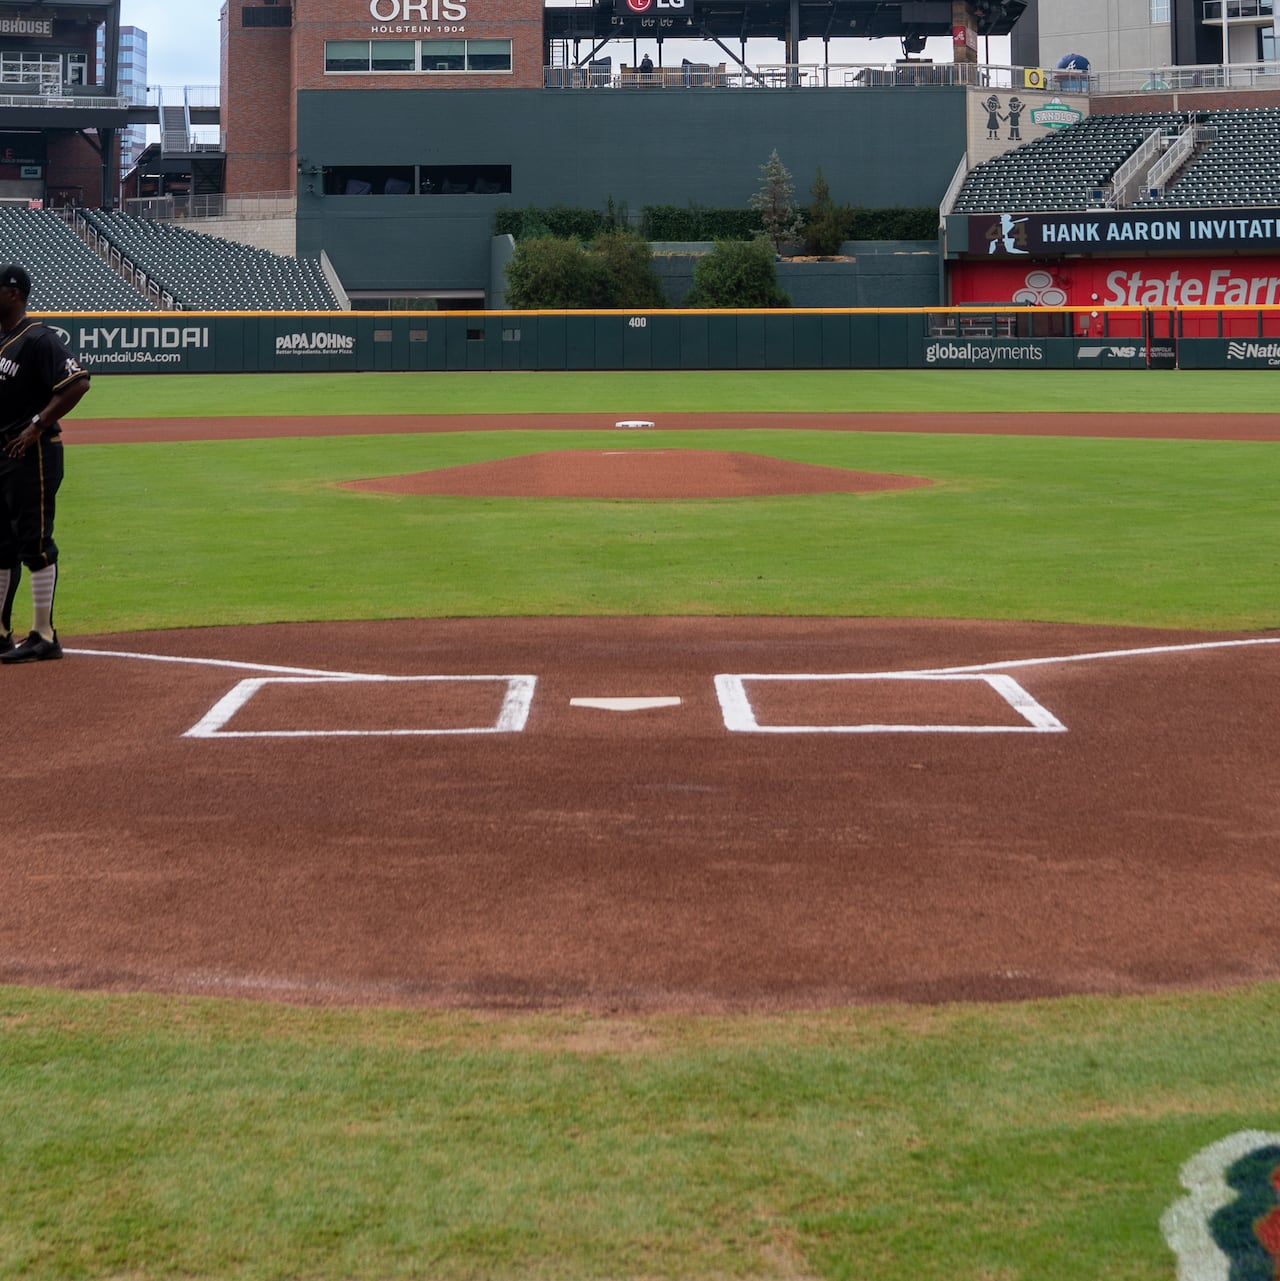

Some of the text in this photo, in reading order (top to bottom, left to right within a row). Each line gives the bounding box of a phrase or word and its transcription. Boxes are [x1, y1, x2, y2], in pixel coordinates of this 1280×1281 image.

[371, 25, 431, 33] HÖLSTEIN
[1042, 223, 1101, 242] HANK
[1106, 221, 1181, 241] AARON
[80, 327, 208, 348] HYUNDAI
[80, 352, 180, 365] HyundaiUSA.com
[926, 342, 1042, 362] globalpayments
